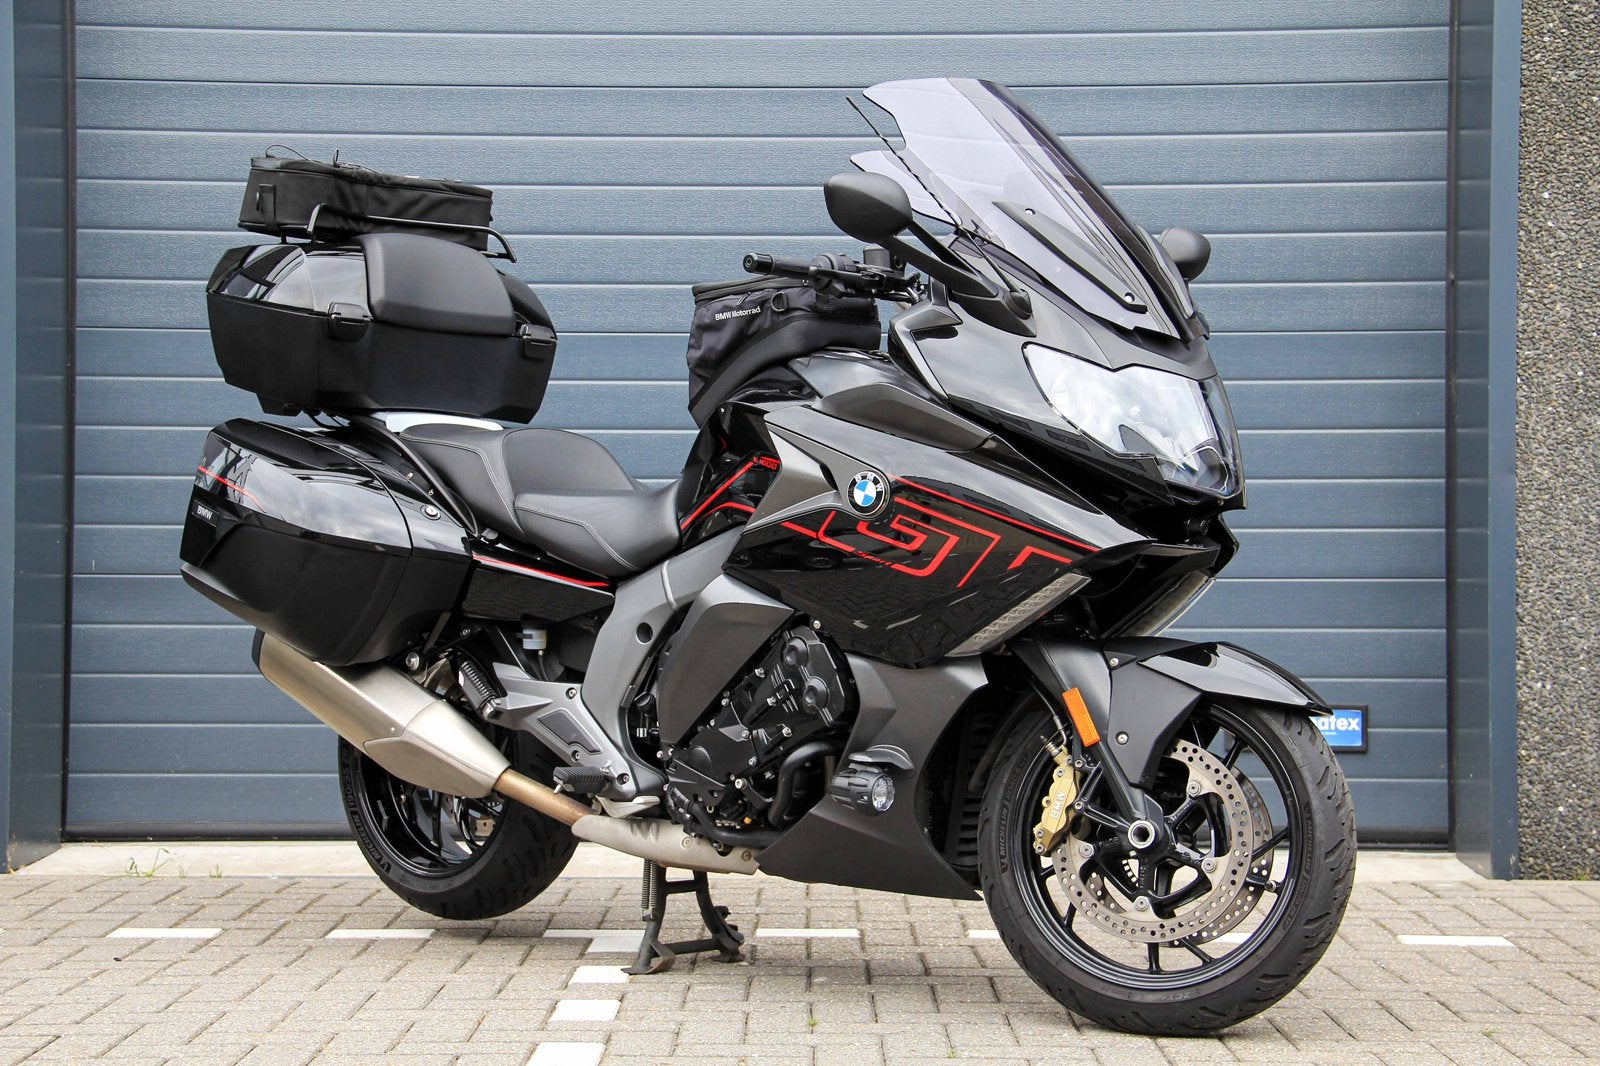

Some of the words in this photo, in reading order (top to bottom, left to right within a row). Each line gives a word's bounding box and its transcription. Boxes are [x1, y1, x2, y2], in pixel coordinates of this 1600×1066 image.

[715, 311, 731, 321] BMW
[731, 305, 761, 318] Motorrad
[854, 472, 884, 492] BMW
[197, 505, 213, 520] BMW
[1051, 792, 1065, 819] BMW
[352, 813, 381, 860] MICHELIN
[1000, 808, 1008, 856] MICHELIN
